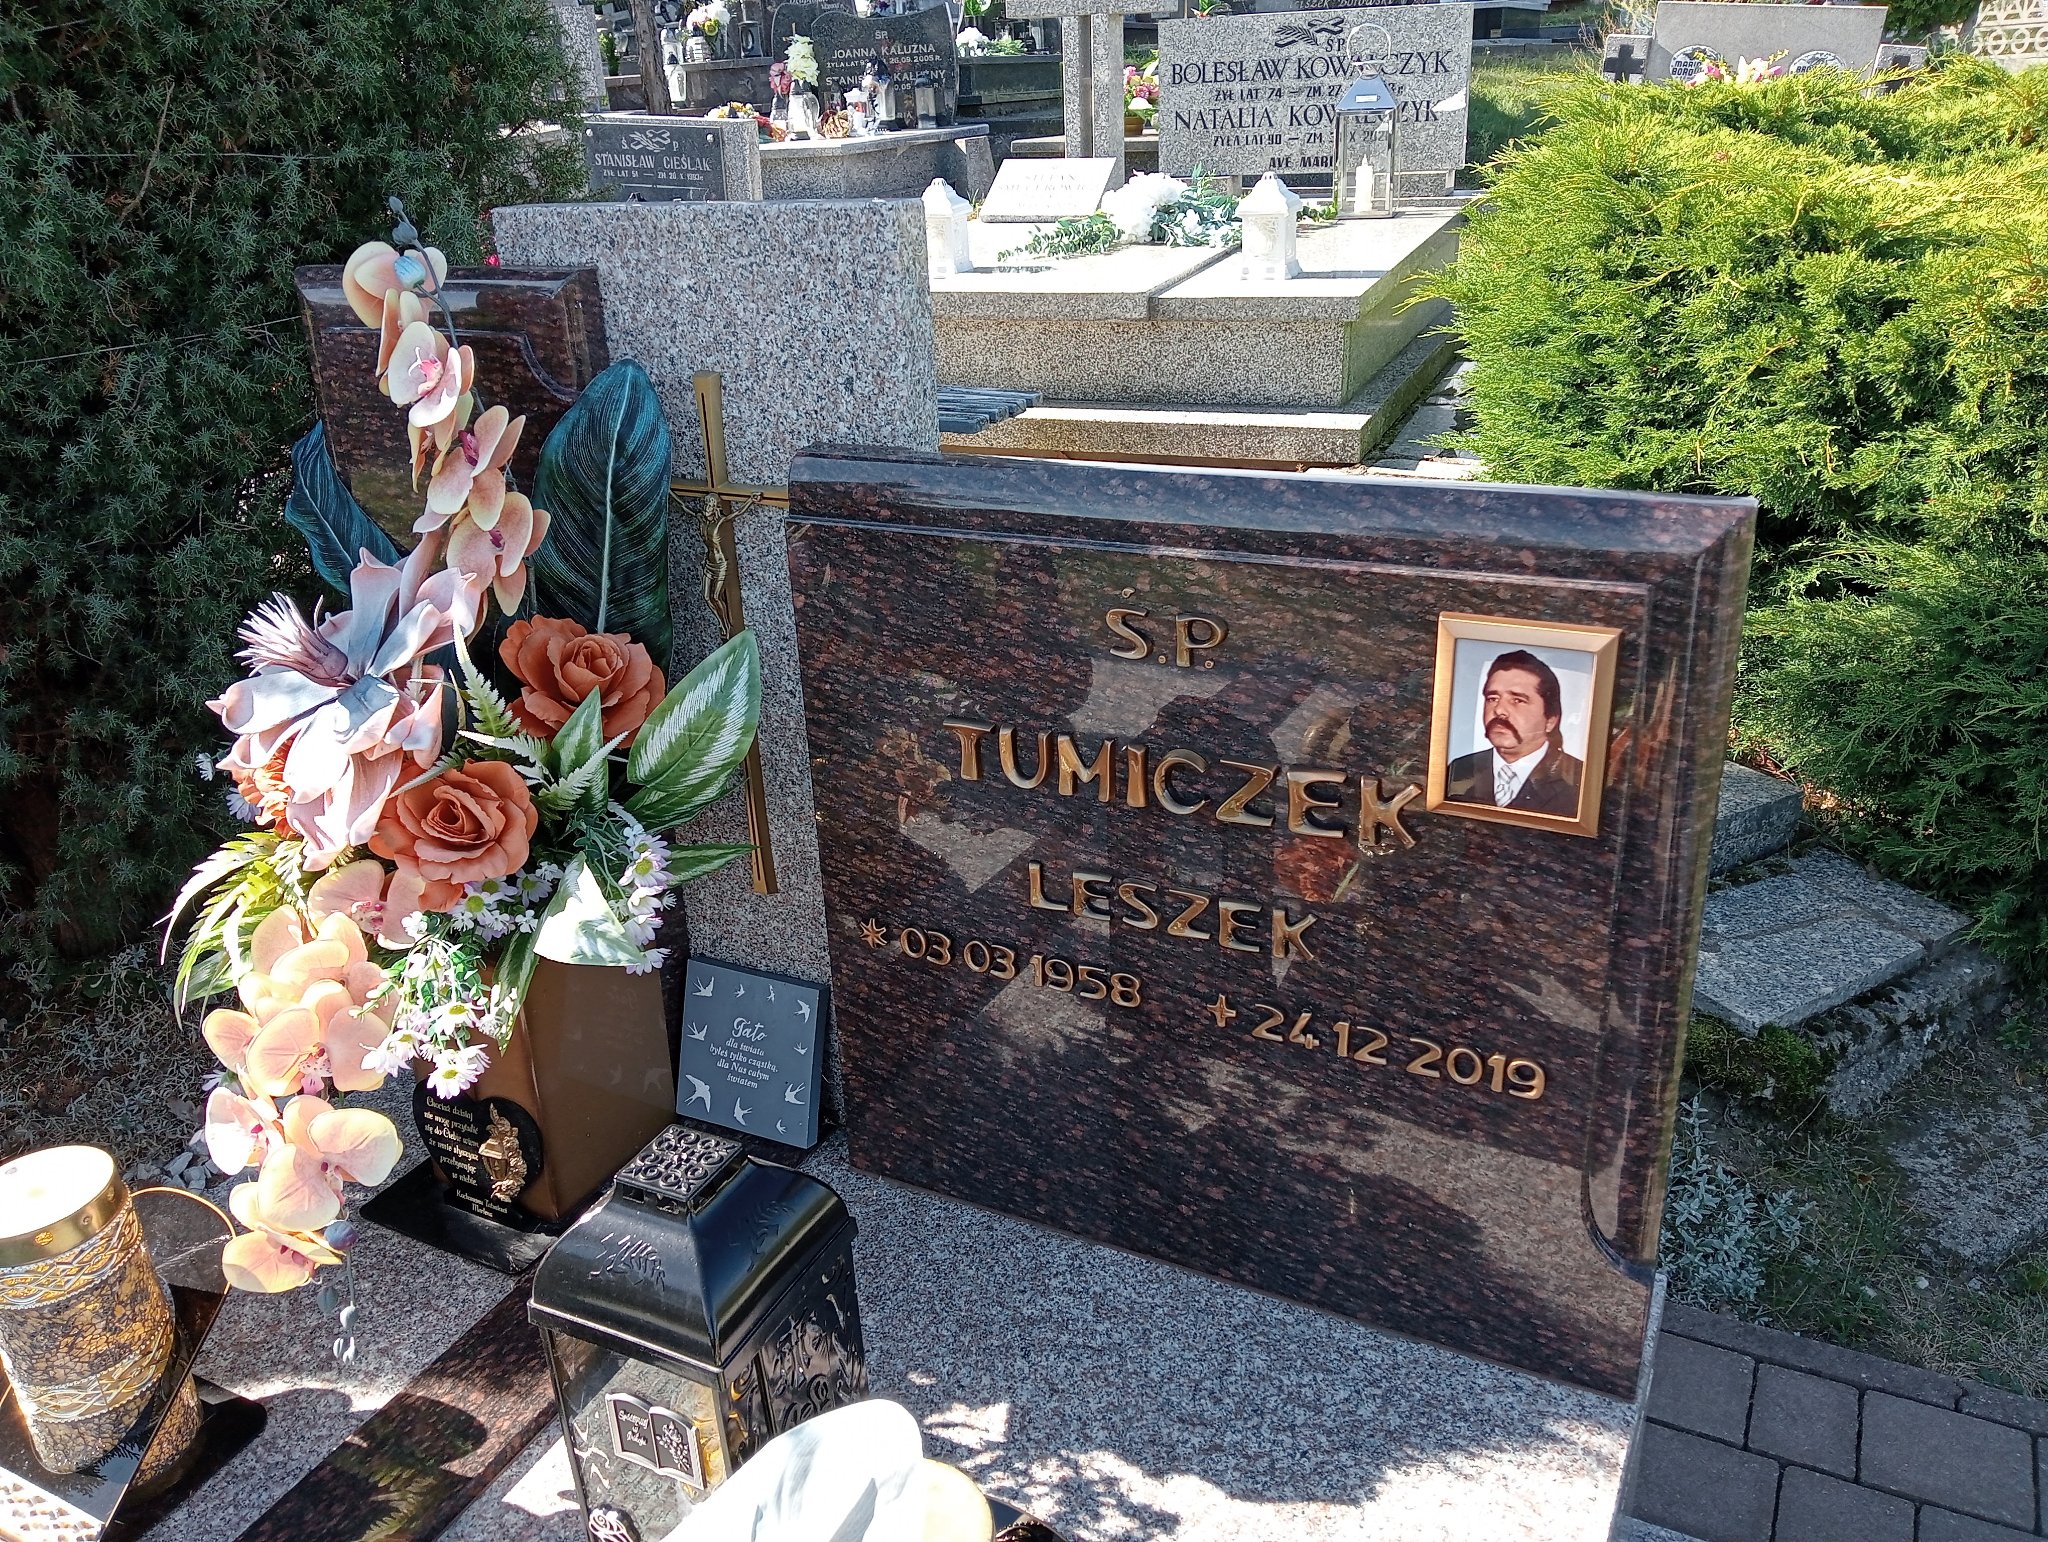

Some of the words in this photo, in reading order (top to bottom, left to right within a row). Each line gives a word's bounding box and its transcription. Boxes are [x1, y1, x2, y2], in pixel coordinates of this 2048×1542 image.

[832, 49, 877, 59] JOANNA
[1172, 58, 1288, 85] BOLESŁAW
[1268, 87, 1282, 99] 74
[1328, 84, 1342, 96] 27
[1174, 106, 1274, 131] NATALIA
[595, 152, 655, 169] STANISŁAW
[663, 153, 713, 171] CIEŚLAK
[1269, 156, 1292, 168] AVE
[1300, 155, 1334, 168] MARI
[942, 716, 1424, 850] TUMICZEK
[1028, 860, 1318, 962] LESZEK
[900, 925, 954, 966] 03
[963, 939, 1019, 981] 03
[1031, 953, 1142, 1009] 1958
[732, 1017, 768, 1041] Tato
[725, 1037, 738, 1049] dla
[1251, 1003, 1321, 1050] 24
[1333, 1021, 1388, 1066] 12
[1406, 1035, 1547, 1101] 2019
[716, 1058, 729, 1069] dla
[731, 1062, 747, 1074] Nas
[729, 1051, 747, 1063] tylko
